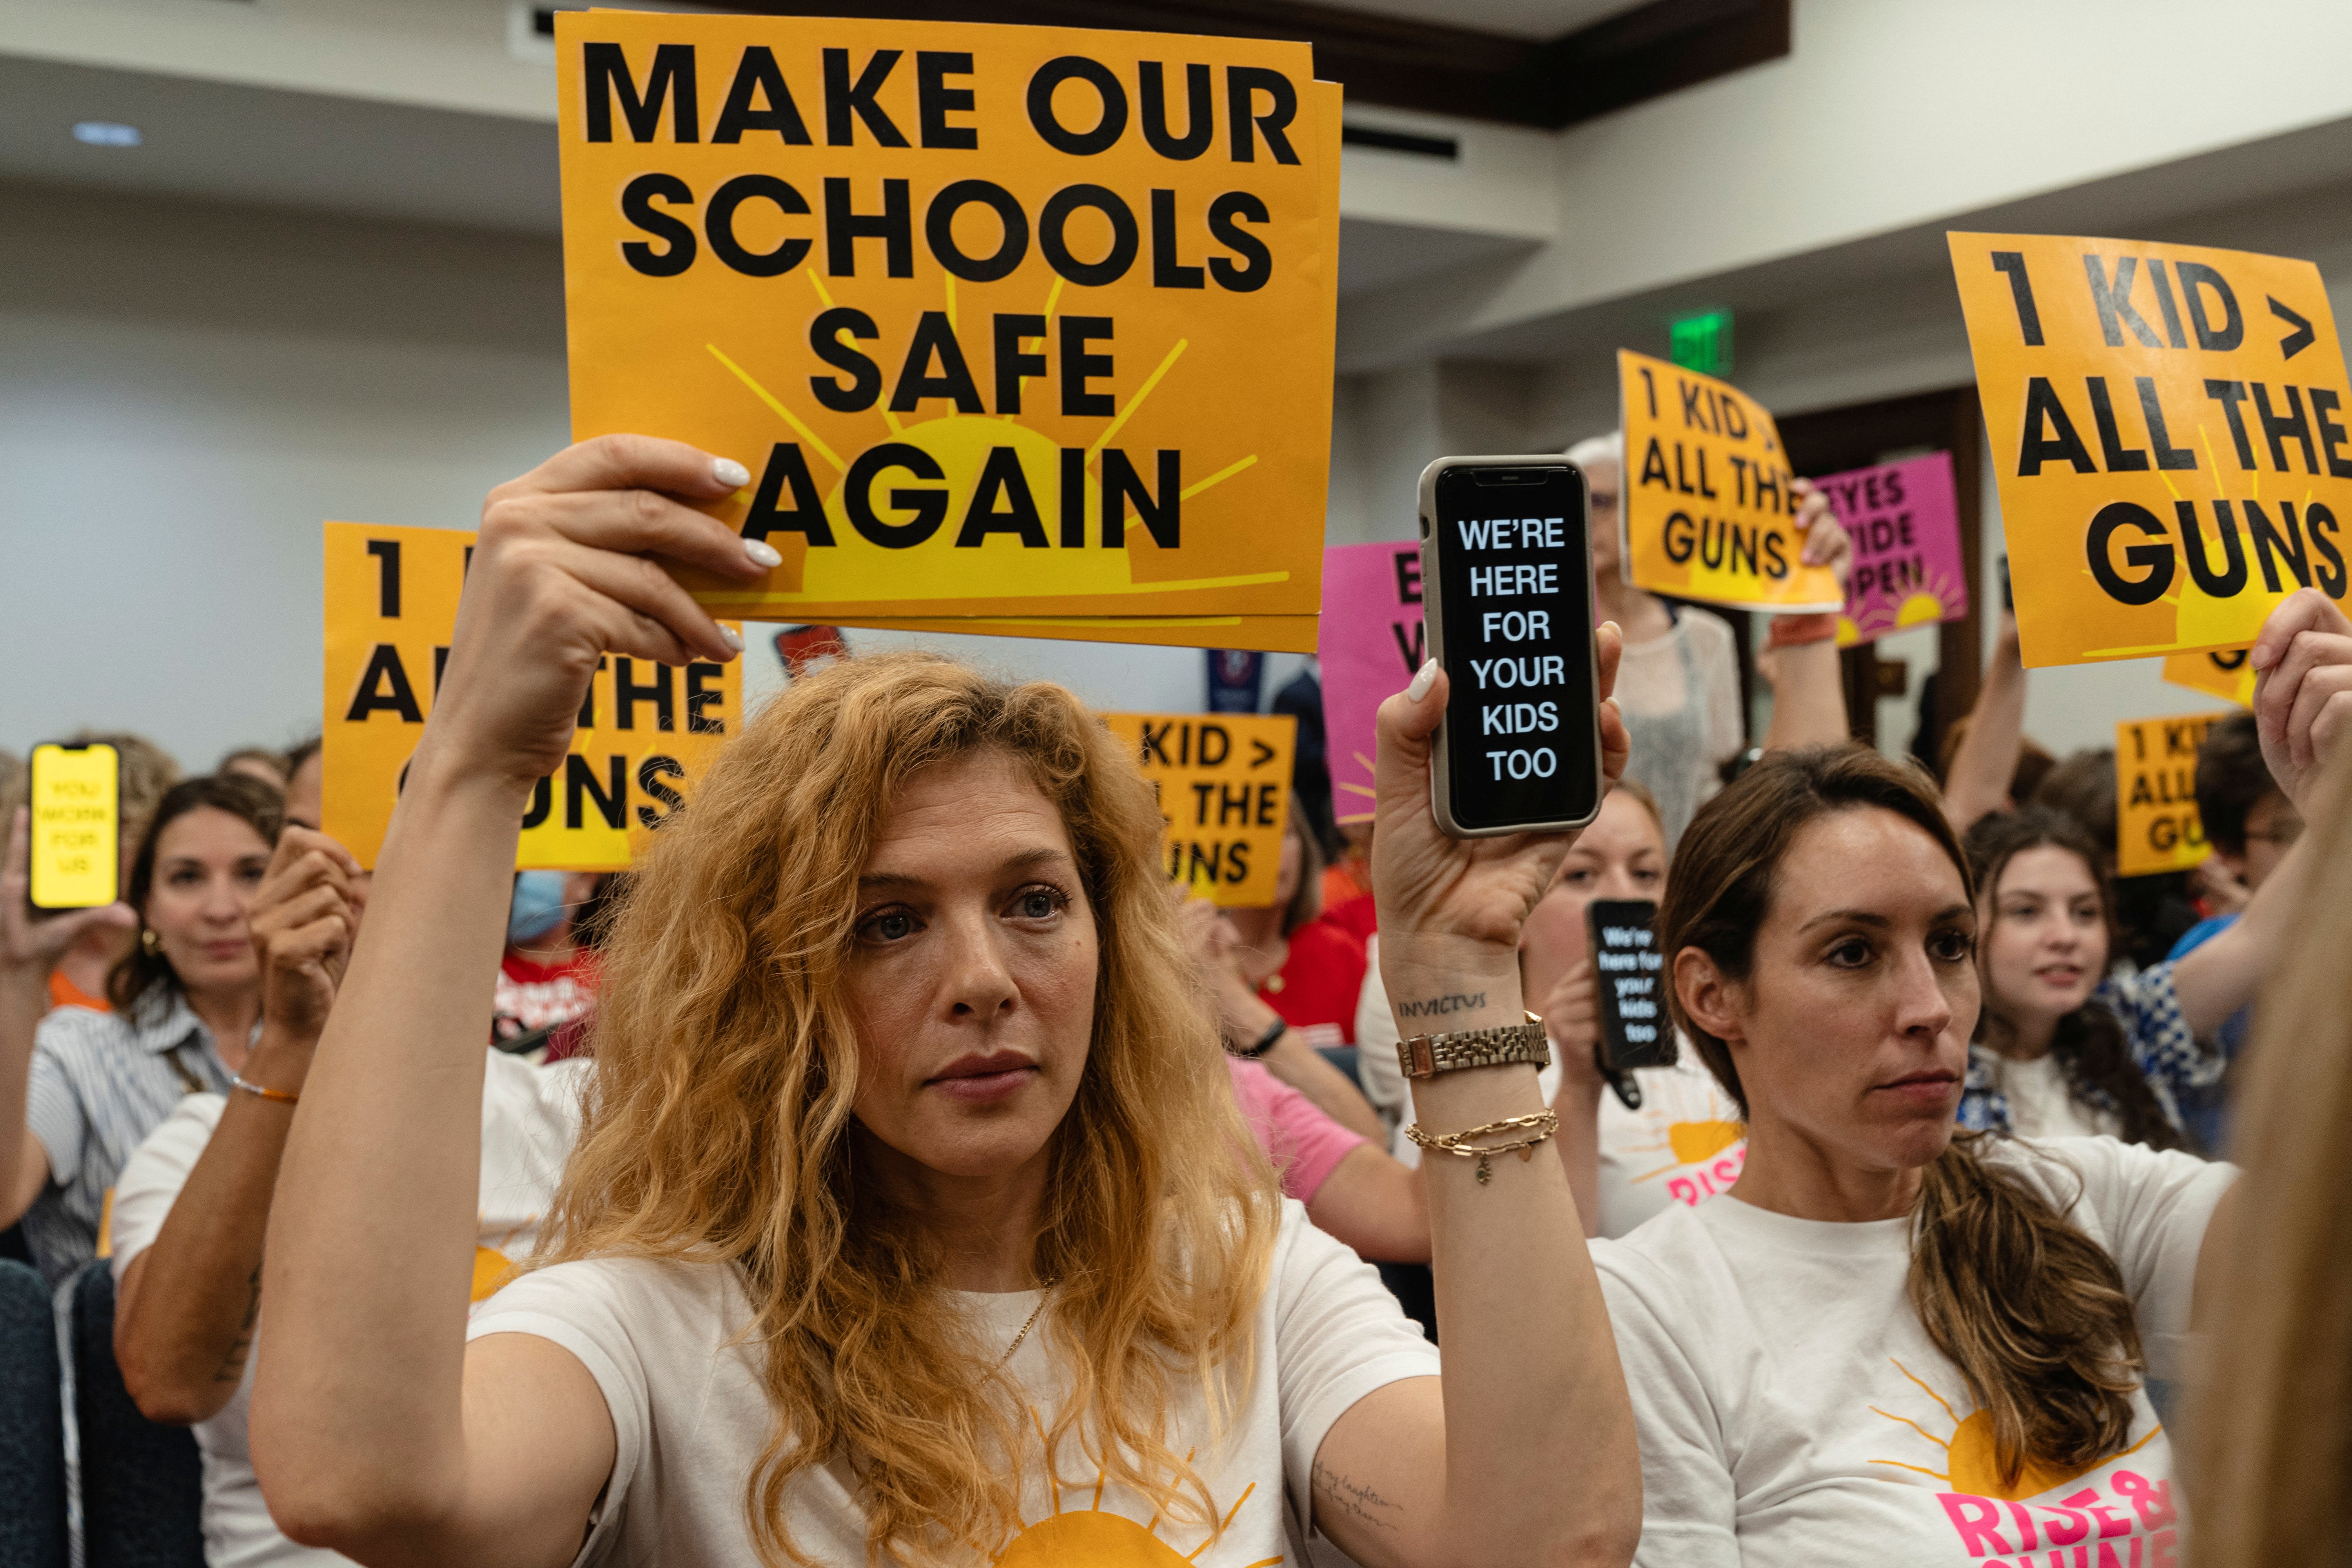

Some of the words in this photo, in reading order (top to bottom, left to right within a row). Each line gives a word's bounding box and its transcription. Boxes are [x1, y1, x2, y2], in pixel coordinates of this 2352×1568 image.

[583, 42, 978, 150] MAKE
[1026, 55, 1302, 165] OUR
[620, 173, 1273, 293] SCHOOLS
[1990, 251, 2045, 346] 1
[2082, 254, 2244, 352] KID
[809, 307, 1116, 417] SAFE
[1639, 368, 1659, 420] 1
[1679, 377, 1749, 442] KID
[2017, 376, 2198, 477] ALL
[2203, 378, 2352, 480] THE
[1641, 438, 1717, 499] ALL
[740, 442, 1181, 550] AGAIN
[1457, 517, 1565, 550] WE'RE
[1662, 512, 1789, 580] GUNS
[1846, 512, 1915, 556] IDE
[2087, 499, 2347, 606] GUNS
[367, 539, 401, 618] 1
[1470, 564, 1559, 596] HERE
[1844, 554, 1923, 604] PEN
[1483, 610, 1550, 642] FOR
[1470, 655, 1566, 690] YOUR
[1483, 701, 1559, 735] KIDS
[1140, 721, 1231, 768] KID
[1486, 747, 1557, 781] TOO
[1192, 782, 1277, 826] THE
[1598, 950, 1639, 971] here
[1639, 949, 1663, 971] for
[1397, 991, 1487, 1018] INVICTUS
[1614, 977, 1655, 999] your
[1618, 998, 1658, 1019] kids
[1624, 1022, 1658, 1043] too
